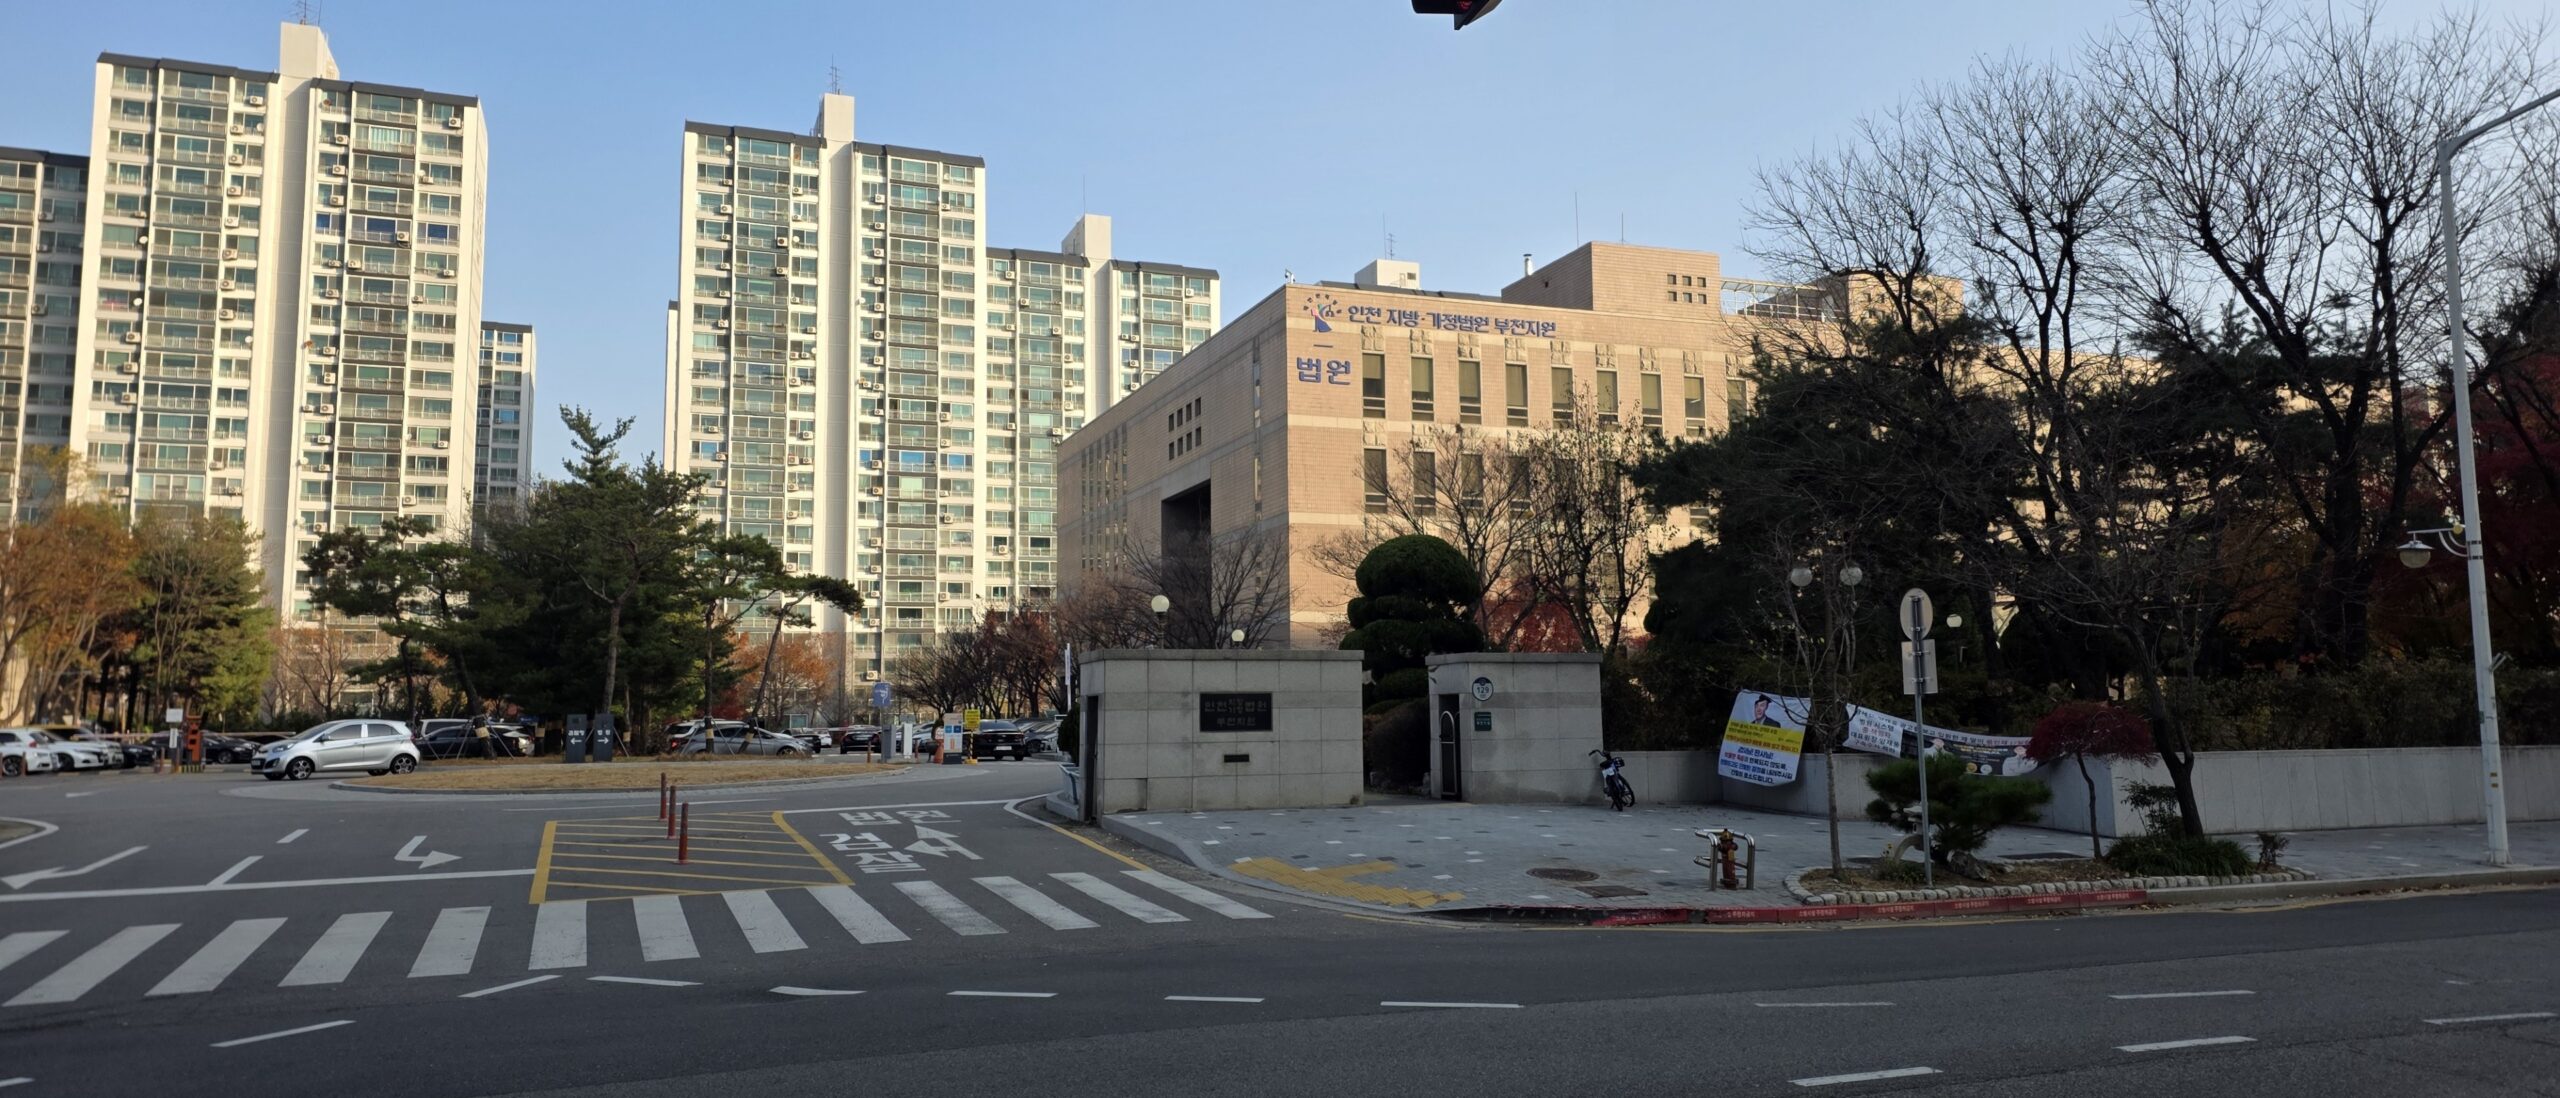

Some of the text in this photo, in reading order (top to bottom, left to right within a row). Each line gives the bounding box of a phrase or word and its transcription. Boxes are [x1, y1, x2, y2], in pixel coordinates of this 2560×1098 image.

[1348, 305, 1382, 325] 인천
[1494, 318, 1556, 338] 부천지원
[1296, 357, 1351, 385] 법원
[1477, 686, 1489, 694] 129
[838, 810, 962, 826] 법원
